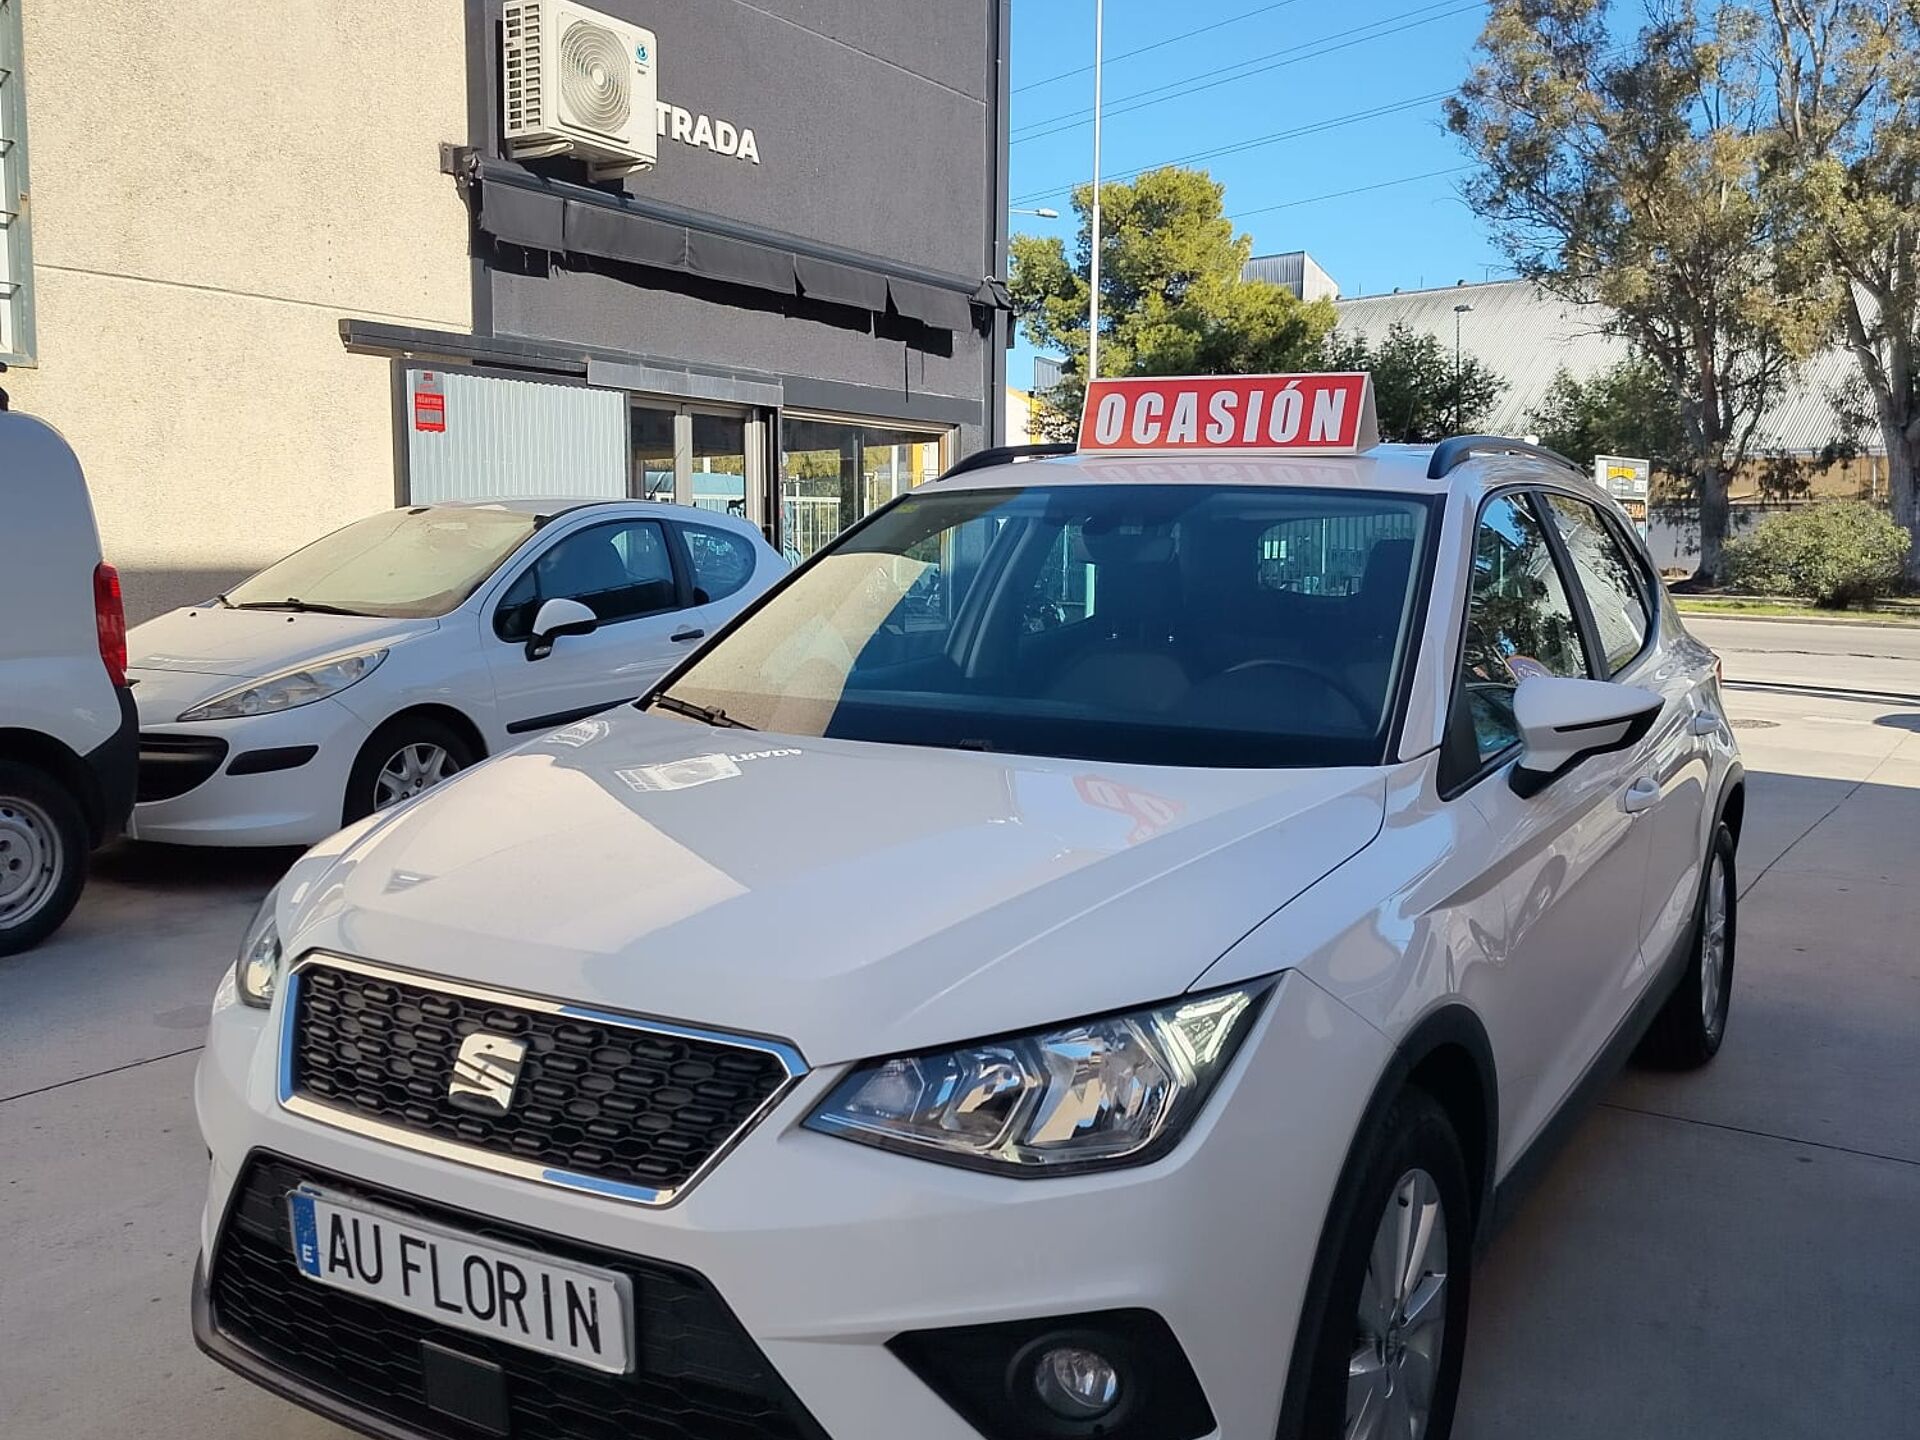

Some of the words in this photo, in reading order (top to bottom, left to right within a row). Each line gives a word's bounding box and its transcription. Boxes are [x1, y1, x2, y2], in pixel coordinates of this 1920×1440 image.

[1095, 380, 1347, 445] OCASIÓN
[302, 1244, 314, 1263] E
[328, 1213, 383, 1284] AU
[399, 1233, 602, 1355] FLORIN
